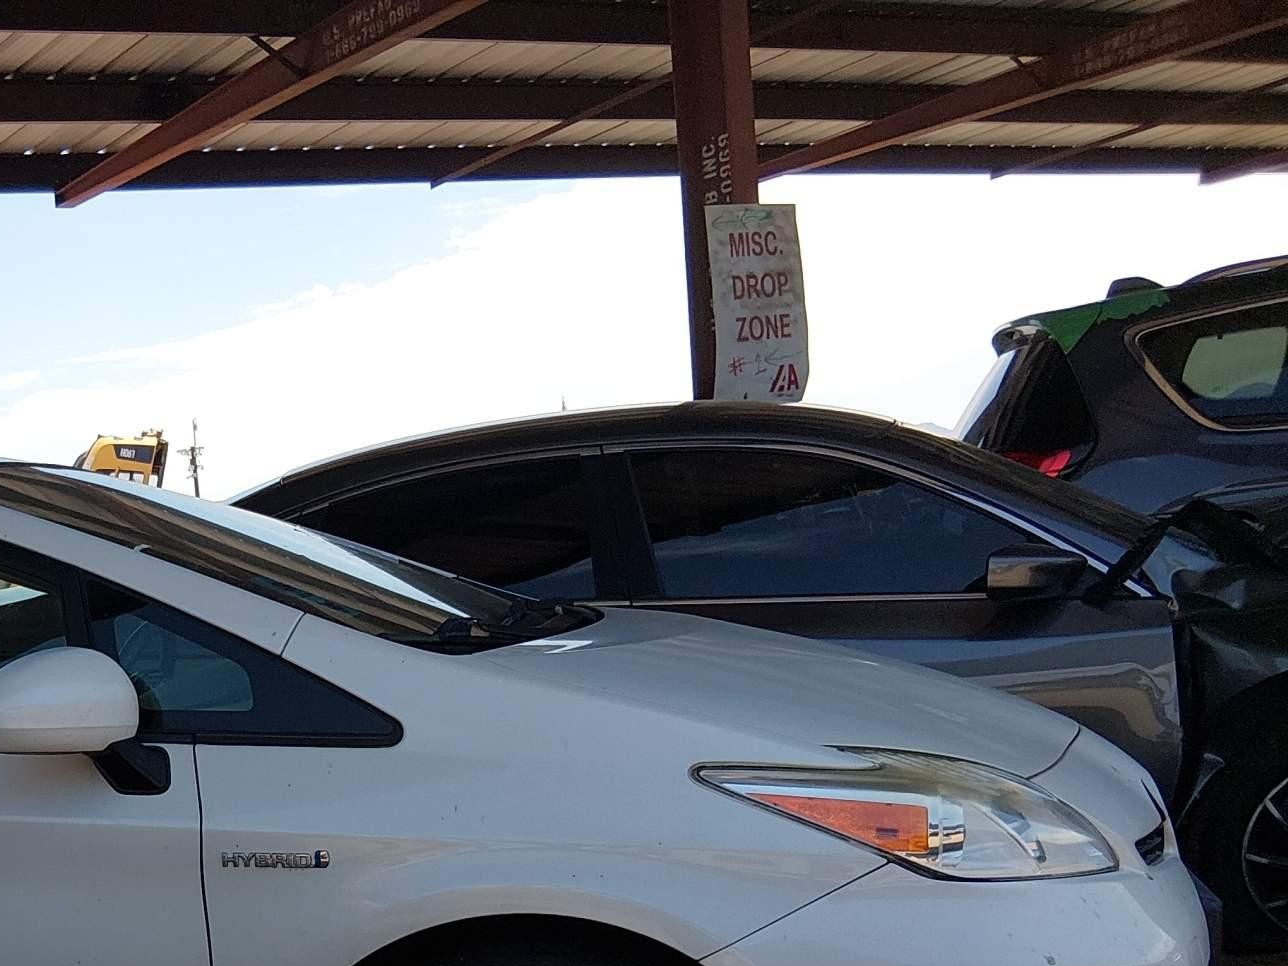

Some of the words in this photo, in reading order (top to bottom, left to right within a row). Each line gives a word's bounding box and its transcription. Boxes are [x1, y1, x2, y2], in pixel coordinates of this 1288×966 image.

[728, 231, 784, 258] MISC.
[732, 272, 789, 301] DROP
[735, 314, 793, 343] ZONE
[220, 852, 313, 869] HYBRID
